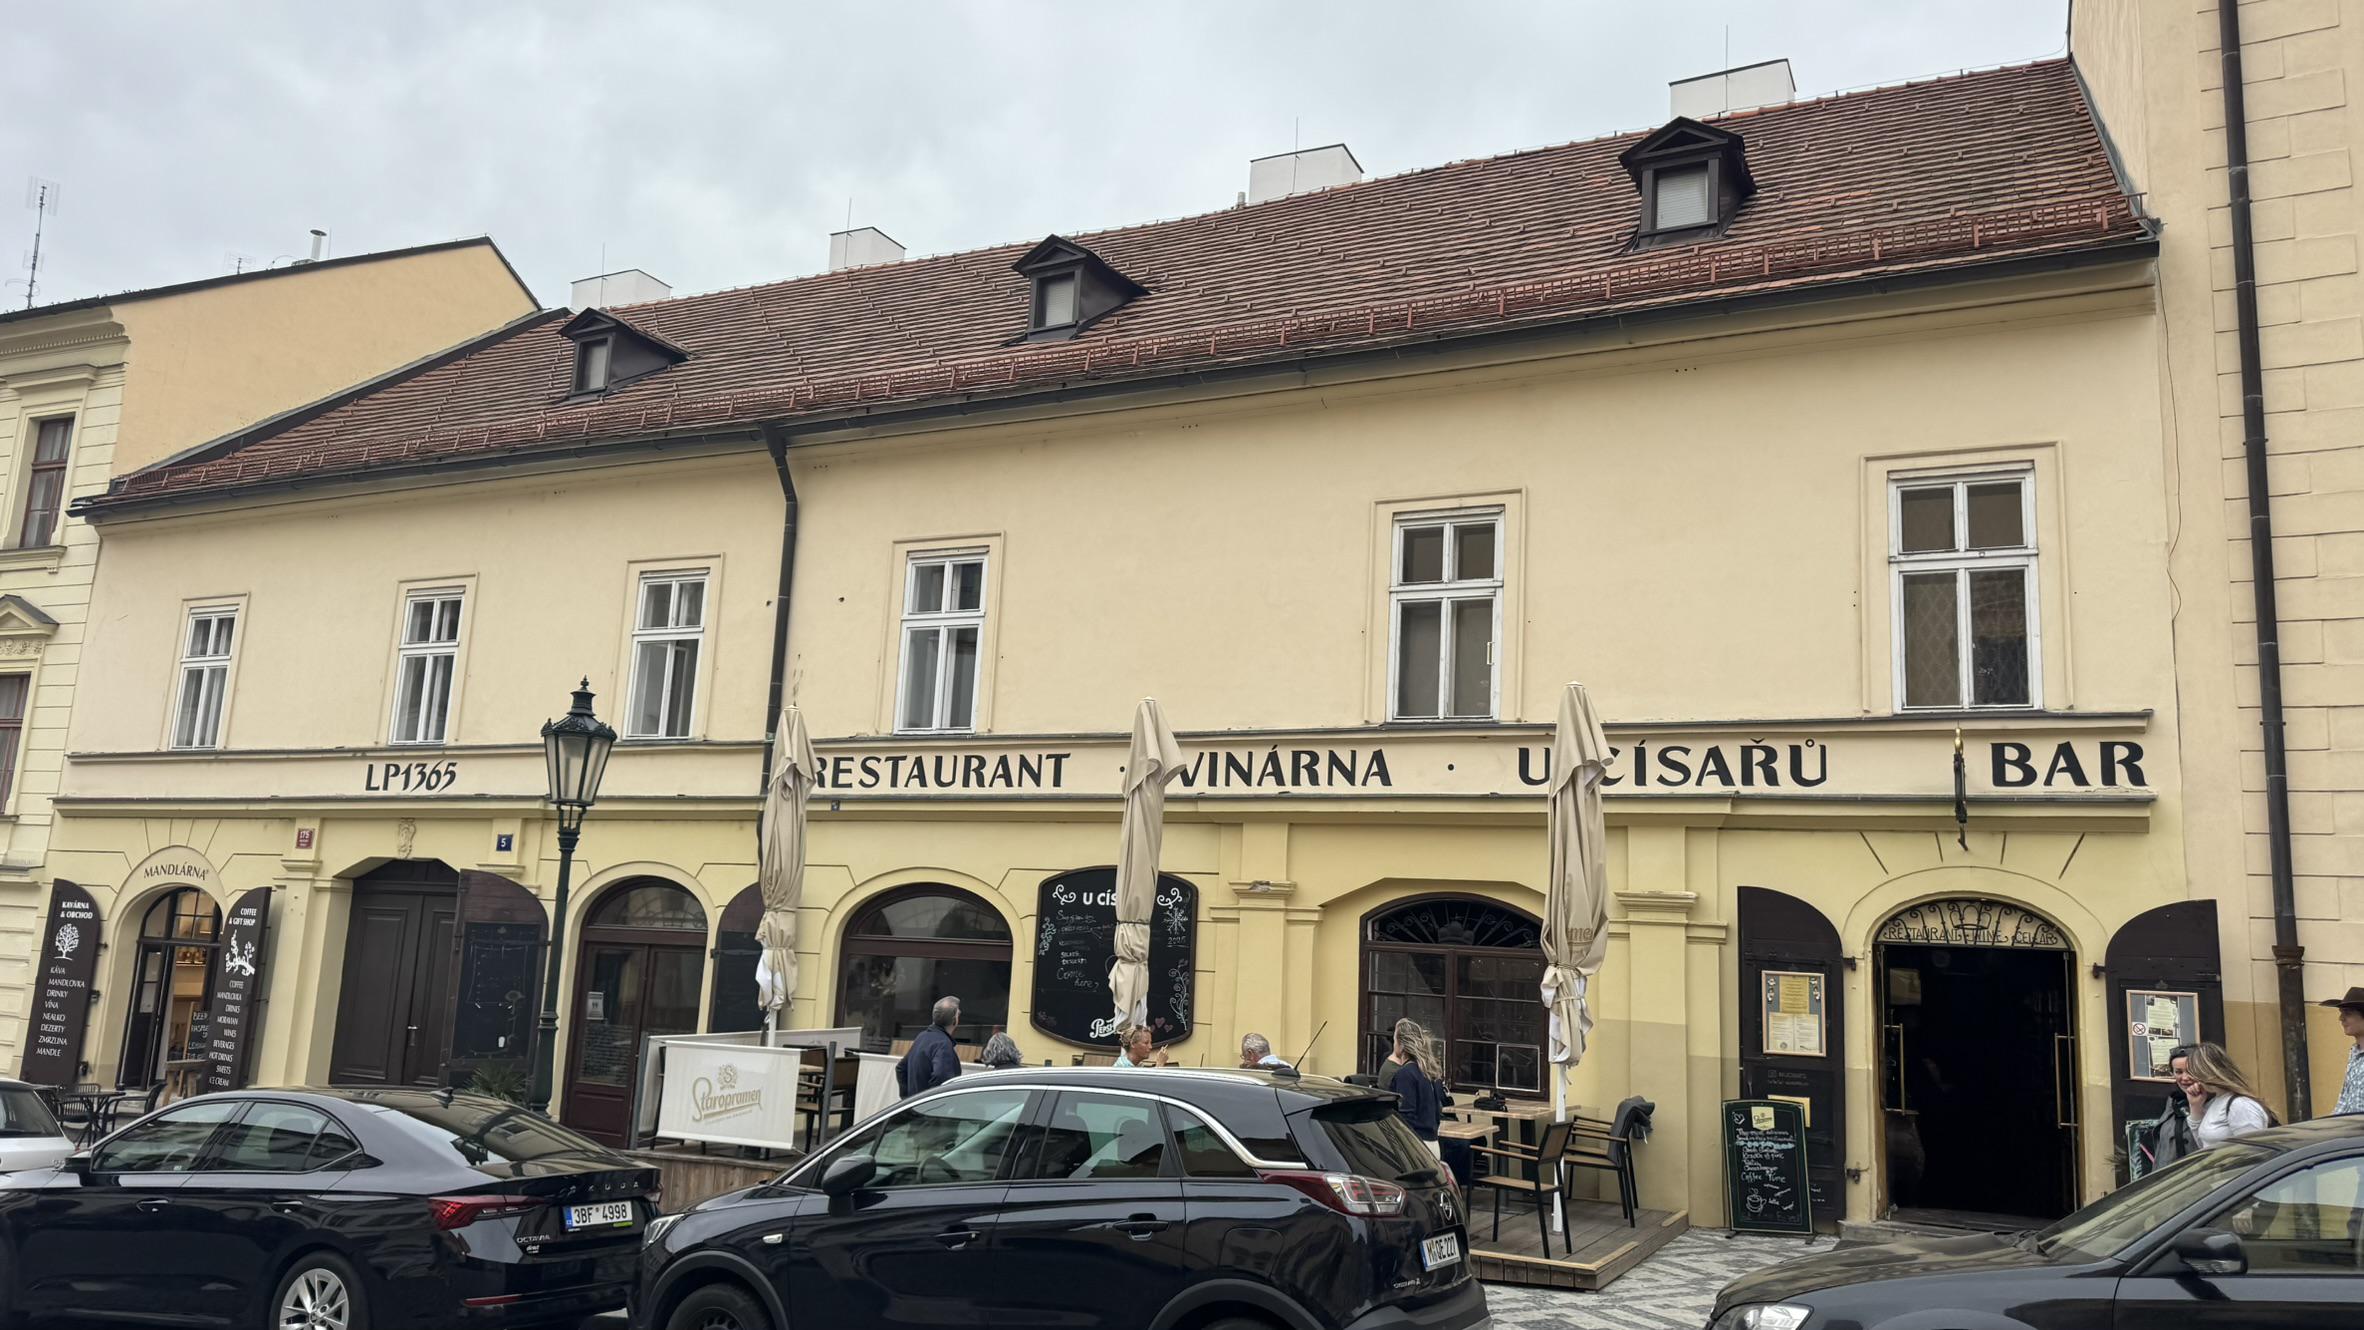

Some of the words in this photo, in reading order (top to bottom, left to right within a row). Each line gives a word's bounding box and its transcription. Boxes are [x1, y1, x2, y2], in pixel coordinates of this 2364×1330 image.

[815, 752, 1071, 788] RESTAURANT
[1179, 744, 1393, 787] VINÁRNA
[1518, 747, 1550, 786] U
[1990, 741, 2148, 787] BAR
[365, 759, 457, 792] LP1365
[500, 837, 506, 847] 5
[1083, 892, 1092, 905] U
[1097, 889, 1117, 905] CÍS
[62, 900, 89, 909] KAVÁRNA
[66, 911, 93, 919] OBCHOD
[240, 908, 257, 916] COFFEE
[233, 917, 242, 926] GIFT
[243, 918, 256, 926] SHOP
[50, 965, 66, 975] KÁVA
[48, 979, 85, 988] MANDLOVKA
[46, 989, 68, 998] DRINKY
[44, 999, 59, 1009] VÍNA
[225, 1004, 240, 1013] DRINKS
[42, 1013, 66, 1022] NEALKO
[40, 1023, 66, 1033] DEZERTY
[38, 1035, 68, 1046] ZMRZLINA
[36, 1047, 61, 1057] MANDLE
[218, 1052, 233, 1063] DRINKS
[216, 1064, 232, 1074] SWEETS
[692, 1077, 763, 1122] Staropramen
[574, 1207, 593, 1224] 3BF
[602, 1203, 627, 1220] 4998
